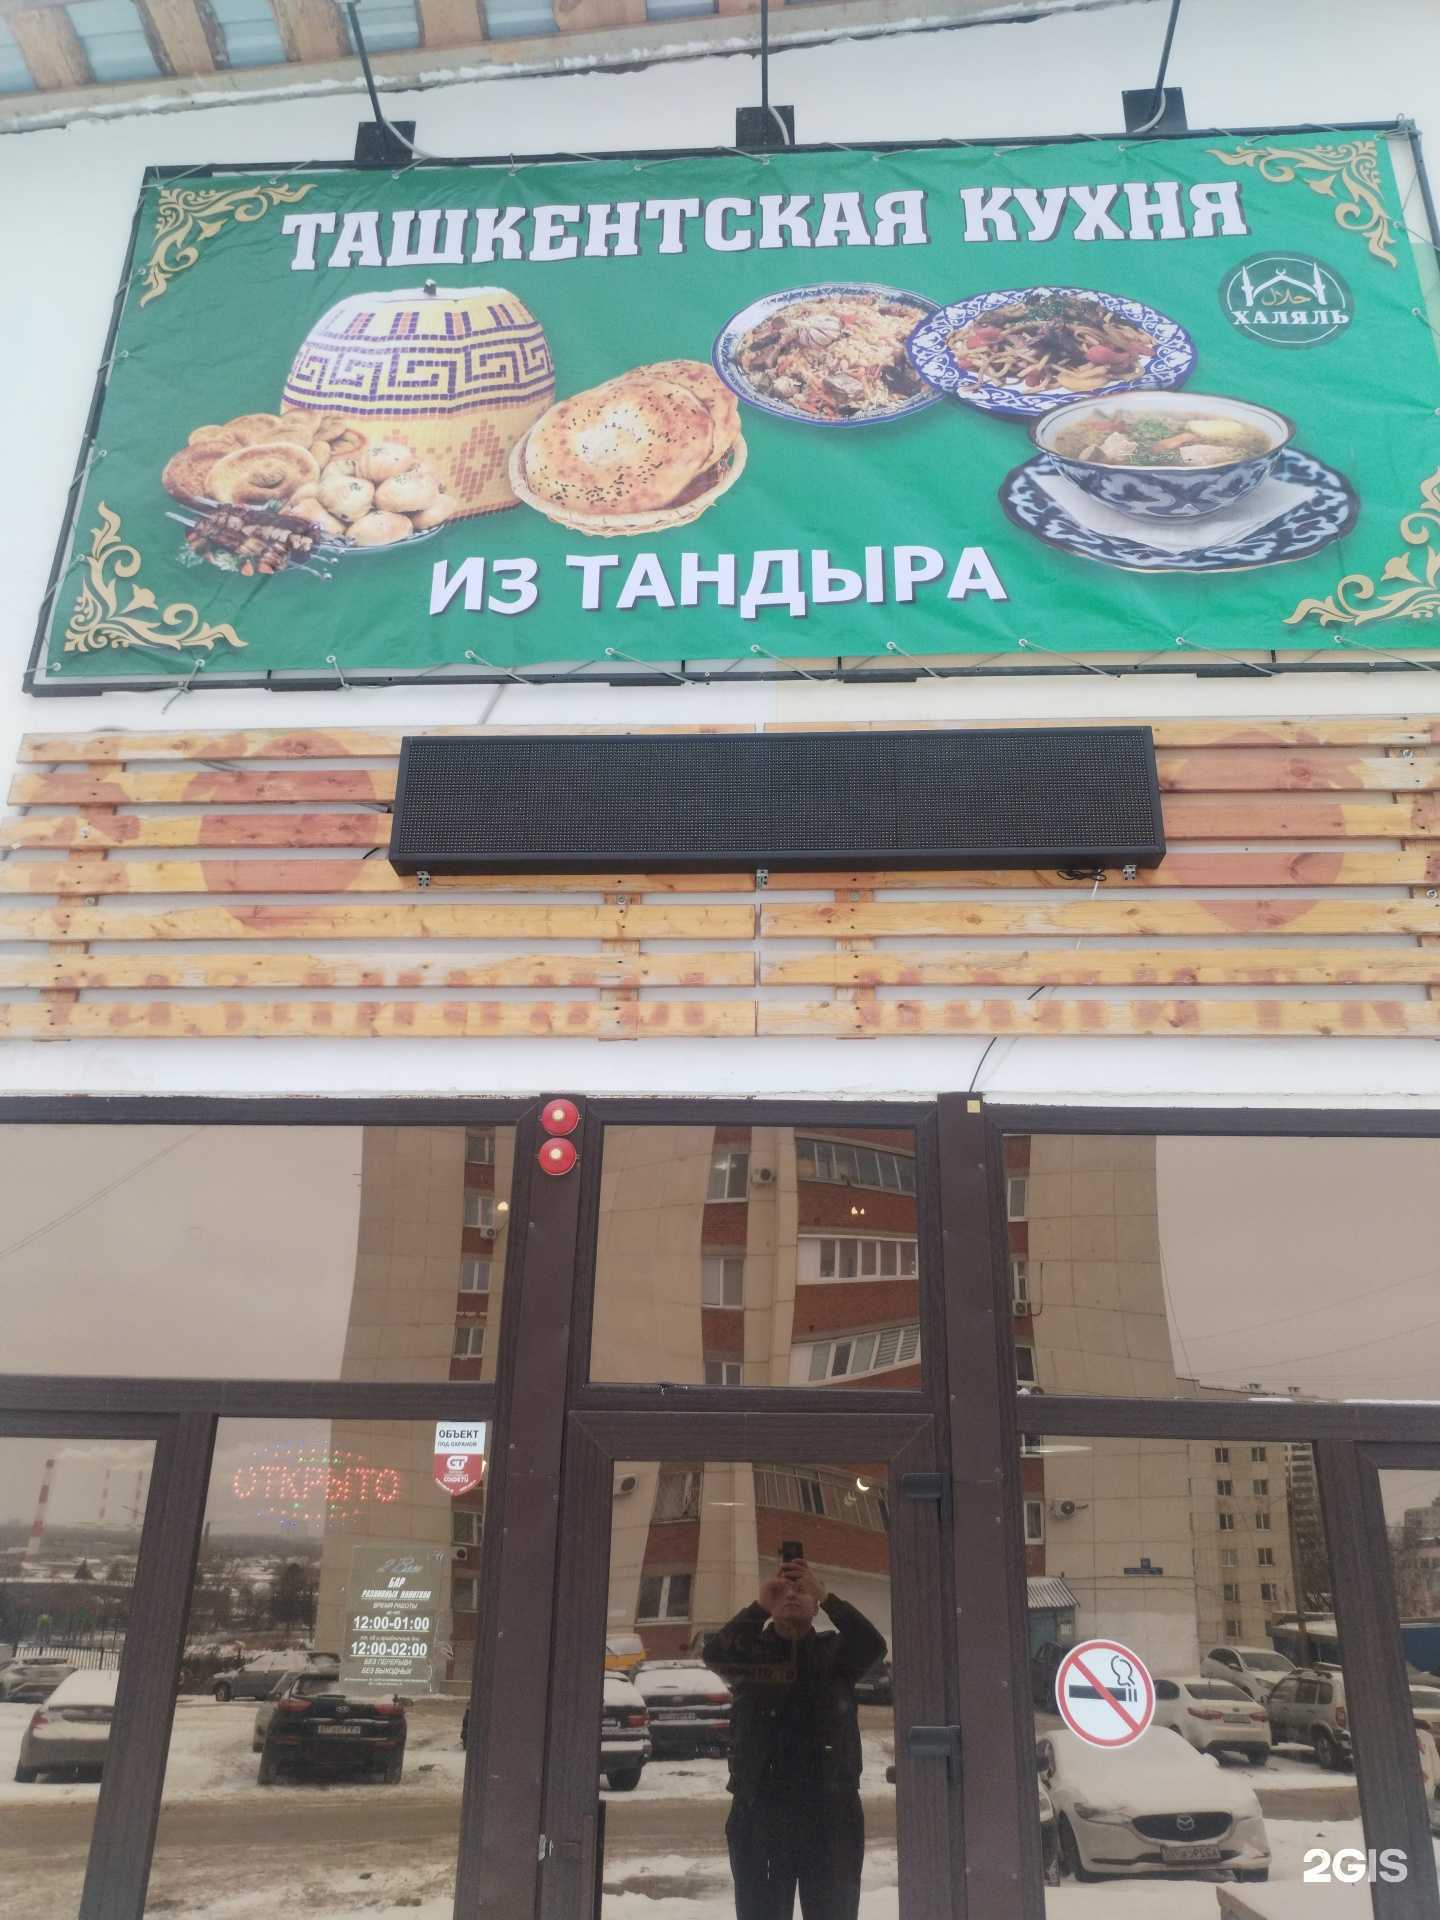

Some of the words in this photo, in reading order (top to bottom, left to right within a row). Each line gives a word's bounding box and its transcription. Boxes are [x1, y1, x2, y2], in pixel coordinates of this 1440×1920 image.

[281, 188, 930, 272] ТАШКЕНТСКАЯ
[961, 180, 1250, 243] КУХНЯ
[1261, 287, 1312, 306] حلال
[1231, 309, 1350, 326] ХАЛЯЛЬ
[429, 554, 538, 617] ИЗ
[565, 545, 1008, 620] ТАНДЫРА
[438, 1429, 479, 1439] ОБЪЕКТ
[233, 1463, 401, 1505] ОТКРЫТО
[388, 1577, 406, 1589] БАР
[353, 1616, 430, 1630] 12:00-01:00
[351, 1642, 428, 1656] 12:00-02:00
